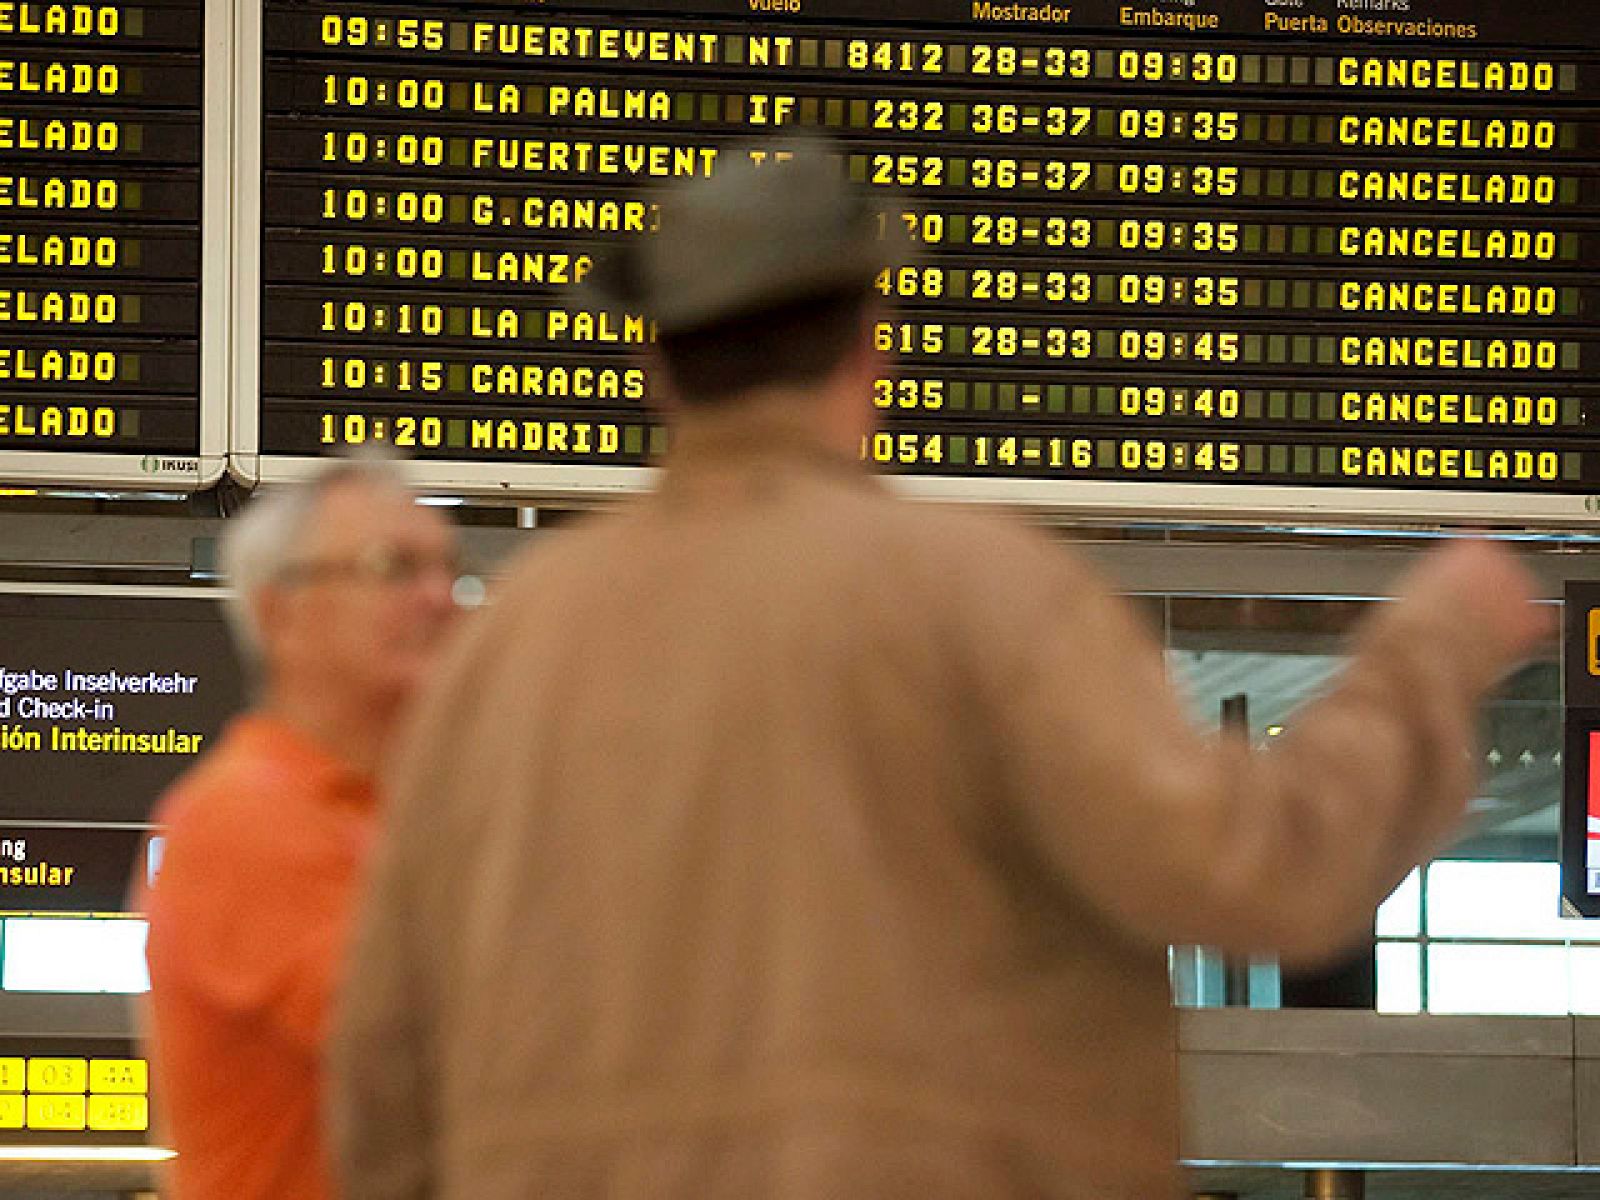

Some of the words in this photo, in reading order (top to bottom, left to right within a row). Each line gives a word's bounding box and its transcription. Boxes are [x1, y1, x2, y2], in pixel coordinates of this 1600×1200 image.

[0, 3, 117, 35] ELADO
[971, 2, 1071, 22] Mostrador
[1119, 6, 1219, 29] Embarque
[1264, 12, 1328, 32] Puerta
[1336, 14, 1478, 38] Observaciones
[323, 15, 443, 50] 09:55
[475, 23, 717, 62] FUERTEVENT
[750, 37, 792, 65] NT
[849, 40, 942, 72] 8412
[973, 45, 1090, 77] 28-33
[1120, 51, 1235, 82] 09:30
[1340, 58, 1552, 90] CANCELADO
[0, 62, 117, 93] ELADO
[325, 75, 443, 108] 10:00
[475, 83, 518, 112] LA
[550, 87, 670, 120] PALMA
[750, 95, 795, 125] IF
[875, 100, 942, 130] 232
[973, 105, 1090, 135] 36-37
[1120, 110, 1237, 140] 09:35
[1340, 117, 1553, 148] CANCELADO
[0, 120, 117, 150] ELADO
[325, 133, 442, 165] 10:00
[475, 140, 717, 177] FUERTEVENT
[873, 155, 942, 185] 252
[973, 160, 1090, 190] 36-37
[1120, 165, 1237, 195] 09:35
[1340, 170, 1553, 203] CANCELADO
[0, 177, 117, 208] ELADO
[323, 190, 442, 222] 10:00
[973, 215, 1090, 247] 28-33
[1120, 220, 1237, 250] 09:35
[1340, 228, 1555, 260] CANCELADO
[0, 235, 115, 265] ELADO
[323, 245, 442, 277] 10:00
[877, 268, 942, 295] 468
[973, 270, 1090, 300] 28-33
[1120, 275, 1237, 305] 09:35
[1340, 283, 1555, 315] CANCELADO
[0, 292, 115, 322] ELADO
[323, 302, 440, 335] 10:10
[473, 308, 517, 337] LA
[548, 312, 656, 342] PALM
[875, 323, 942, 352] 615
[973, 327, 1090, 357] 28-33
[1120, 330, 1238, 360] 09:45
[1341, 338, 1555, 368] CANCELADO
[0, 350, 115, 380] ELADO
[322, 358, 440, 390] 10:15
[473, 365, 643, 398] CARACAS
[873, 380, 942, 408] 335
[1120, 388, 1238, 417] 09:40
[1342, 393, 1555, 425] CANCELADO
[0, 405, 113, 435] ELADO
[322, 415, 440, 450] 10:20
[472, 420, 618, 452] MADRID
[860, 433, 942, 462] 054
[975, 438, 1090, 467] 14-16
[1122, 440, 1238, 470] 09:45
[1343, 448, 1557, 480] CANCELADO
[65, 669, 198, 693] Inselverkehr
[18, 698, 114, 720] Check-in
[2, 725, 41, 749] ión
[52, 726, 203, 753] Interinsular
[0, 861, 74, 886] nsular
